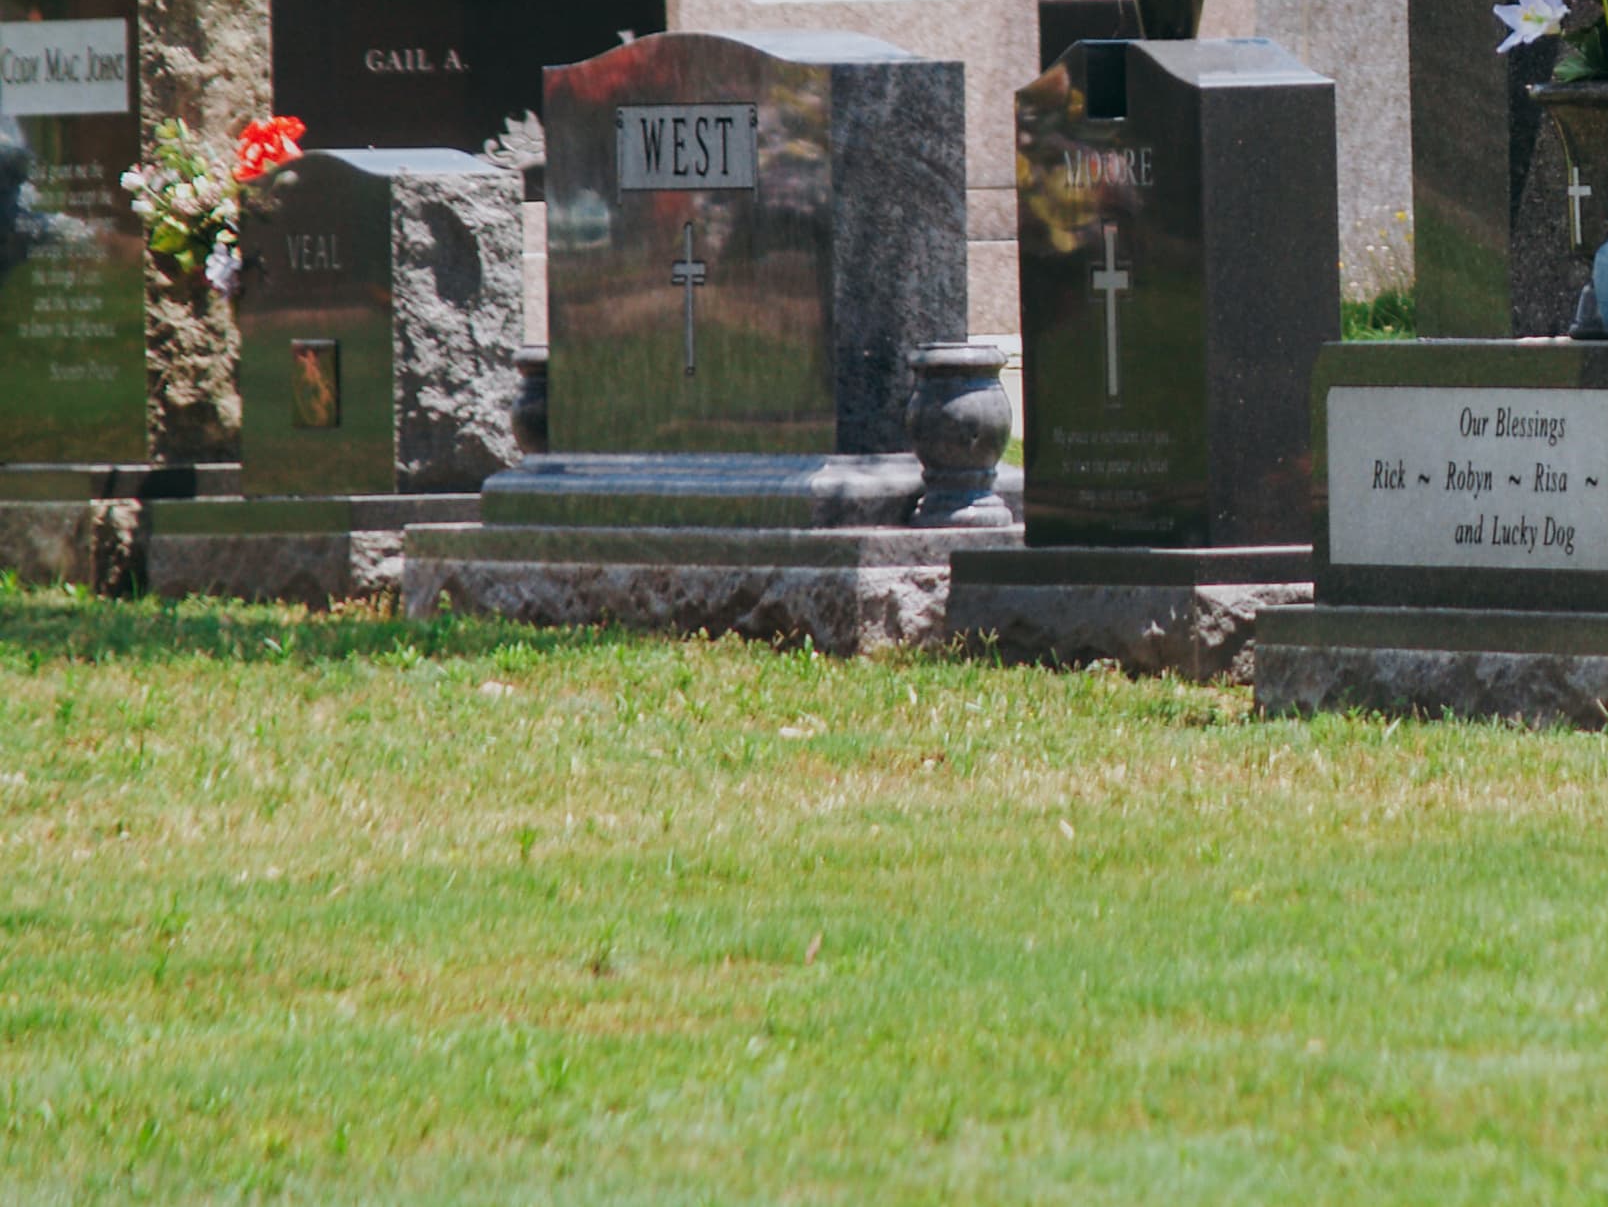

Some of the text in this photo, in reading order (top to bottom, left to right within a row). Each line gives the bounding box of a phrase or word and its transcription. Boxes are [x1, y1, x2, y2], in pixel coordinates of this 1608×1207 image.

[365, 47, 471, 72] GAIL A.
[640, 117, 733, 177] WEST
[1063, 147, 1154, 188] MOORE
[286, 234, 342, 271] VEAL
[1460, 407, 1566, 446] Our Blessings
[1372, 459, 1406, 490] Rick
[1445, 460, 1493, 498] Robyn
[1534, 462, 1568, 493] Risa
[1455, 514, 1576, 555] and Lucky Dog
